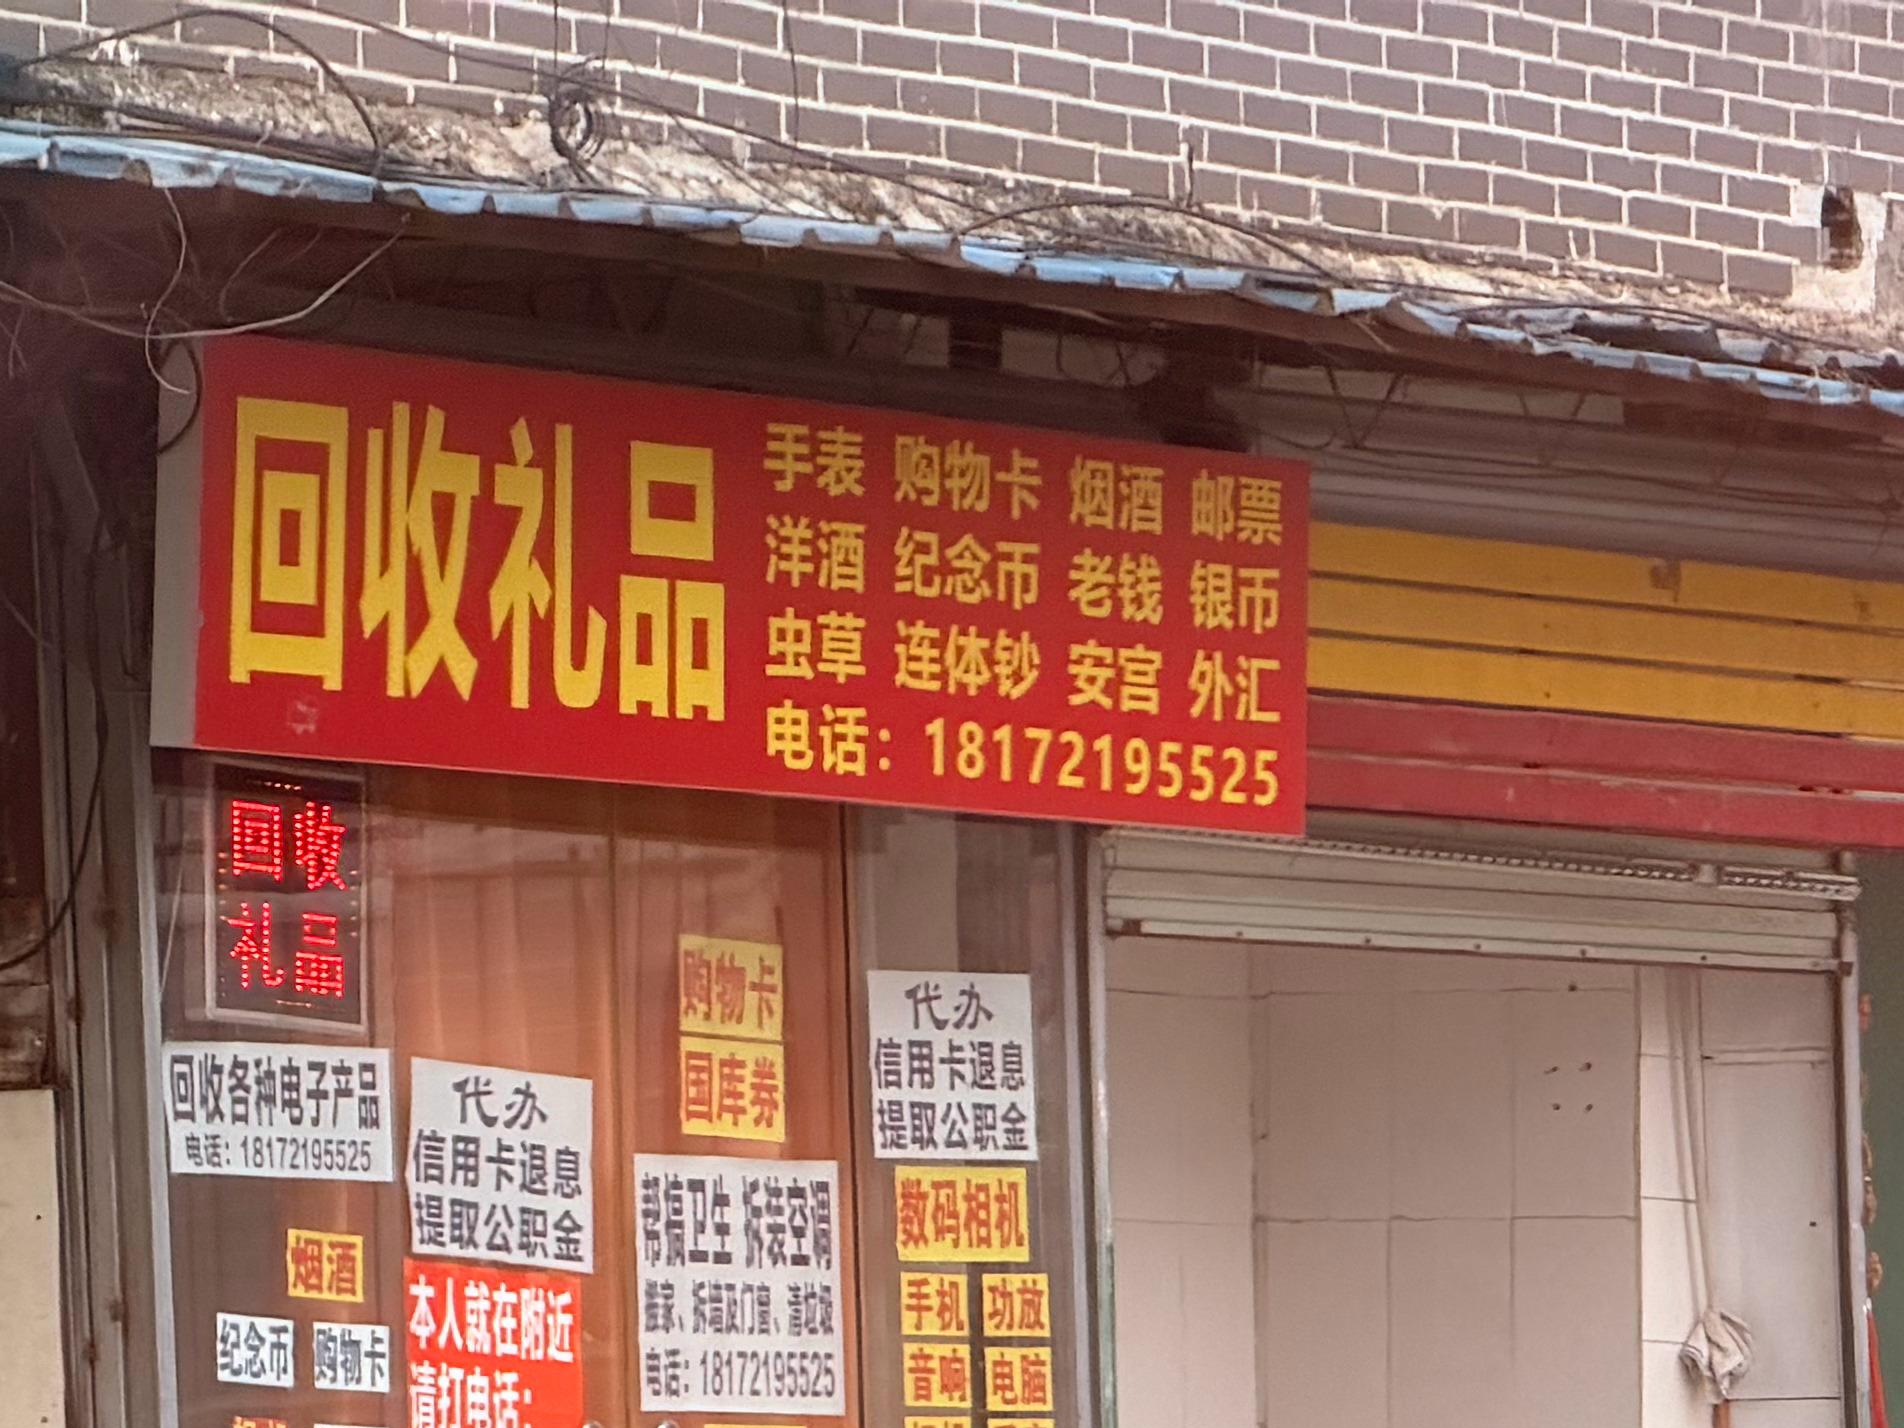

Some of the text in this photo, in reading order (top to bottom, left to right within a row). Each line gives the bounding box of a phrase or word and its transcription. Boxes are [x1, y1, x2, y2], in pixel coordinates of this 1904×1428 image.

[763, 422, 1284, 547] 手表 购物卡 烟酒 邮票
[229, 396, 726, 722] 回收礼品
[763, 514, 1280, 635] 洋酒 纪念币 老钱 银币
[765, 608, 1280, 727] 虫草 连体钞 安宫 外汇
[232, 800, 346, 890] 回收
[222, 902, 344, 999] 礼品
[683, 948, 779, 1031] 购物卡
[905, 982, 993, 1031] 代办
[169, 1054, 380, 1131] 回收各种电子产品
[683, 1049, 780, 1129] 国库券
[875, 1038, 1025, 1092] 信用卡退息
[452, 1076, 548, 1131] 代办
[877, 1099, 1029, 1151] 提取公职金
[413, 1129, 583, 1199] 信用卡退息
[415, 1193, 584, 1264] 提取公职金
[743, 1175, 832, 1270] 拆装空调
[899, 1178, 1025, 1250] 数码相机
[291, 1237, 358, 1298] 烟酒
[987, 1277, 1045, 1329] 功放
[408, 1275, 574, 1363] 本人就在附近
[905, 1277, 967, 1332] 手机
[219, 1320, 289, 1383] 纪念币
[315, 1330, 388, 1390] 购物卡
[908, 1348, 967, 1403] 音响
[992, 1348, 1048, 1407] 电脑
